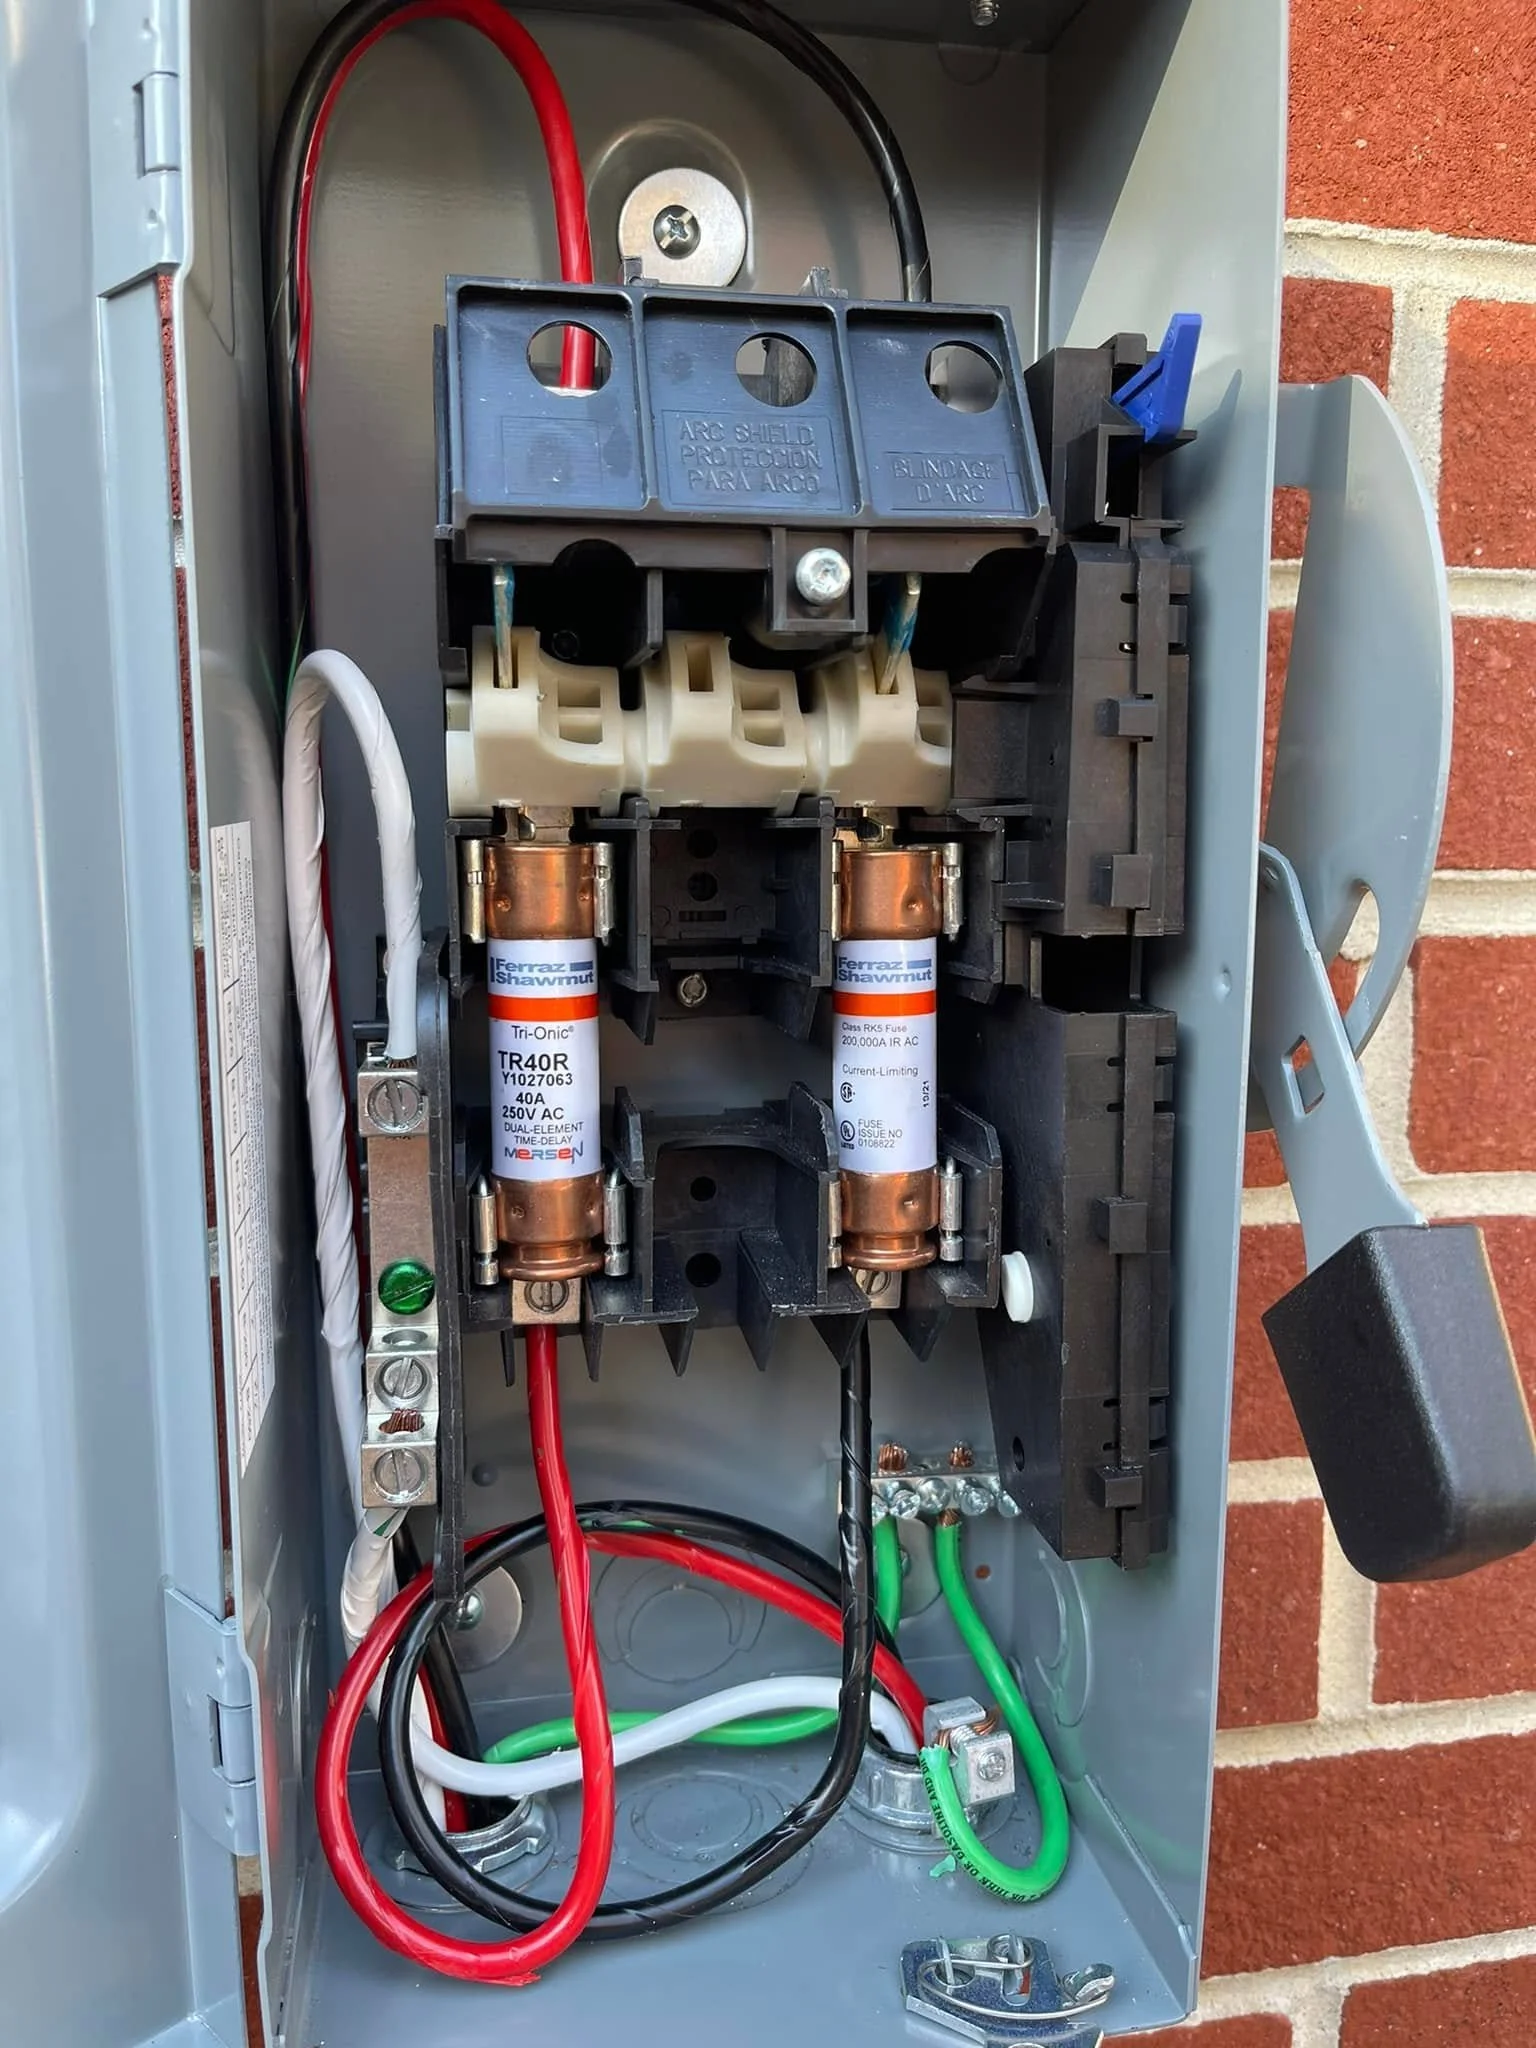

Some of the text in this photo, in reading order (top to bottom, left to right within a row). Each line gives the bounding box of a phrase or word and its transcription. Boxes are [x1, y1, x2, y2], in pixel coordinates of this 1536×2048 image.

[680, 419, 816, 447] ARC SHIELD
[688, 469, 821, 495] PARA ARCO
[496, 958, 566, 973] Ferraz
[838, 956, 904, 971] Ferraz
[496, 971, 594, 987] Shawmut
[838, 968, 933, 984] Shawmut
[842, 1022, 908, 1033] Class RK5 Fuse
[842, 1035, 919, 1048] 200,000A IR AC
[498, 1051, 569, 1072] TR40R
[842, 1063, 919, 1078] Current-Limiting
[502, 1072, 573, 1087] Y1027063
[515, 1092, 545, 1105] 40A
[502, 1105, 565, 1120] 250V AC
[504, 1122, 583, 1134] DUAL-ELEMENT
[858, 1119, 883, 1129] FUSE
[514, 1135, 572, 1146] TIME-DELAY
[858, 1128, 903, 1139] ISSUE NO
[924, 1776, 939, 1802] AND
[931, 1803, 967, 1861] GASOLINE
